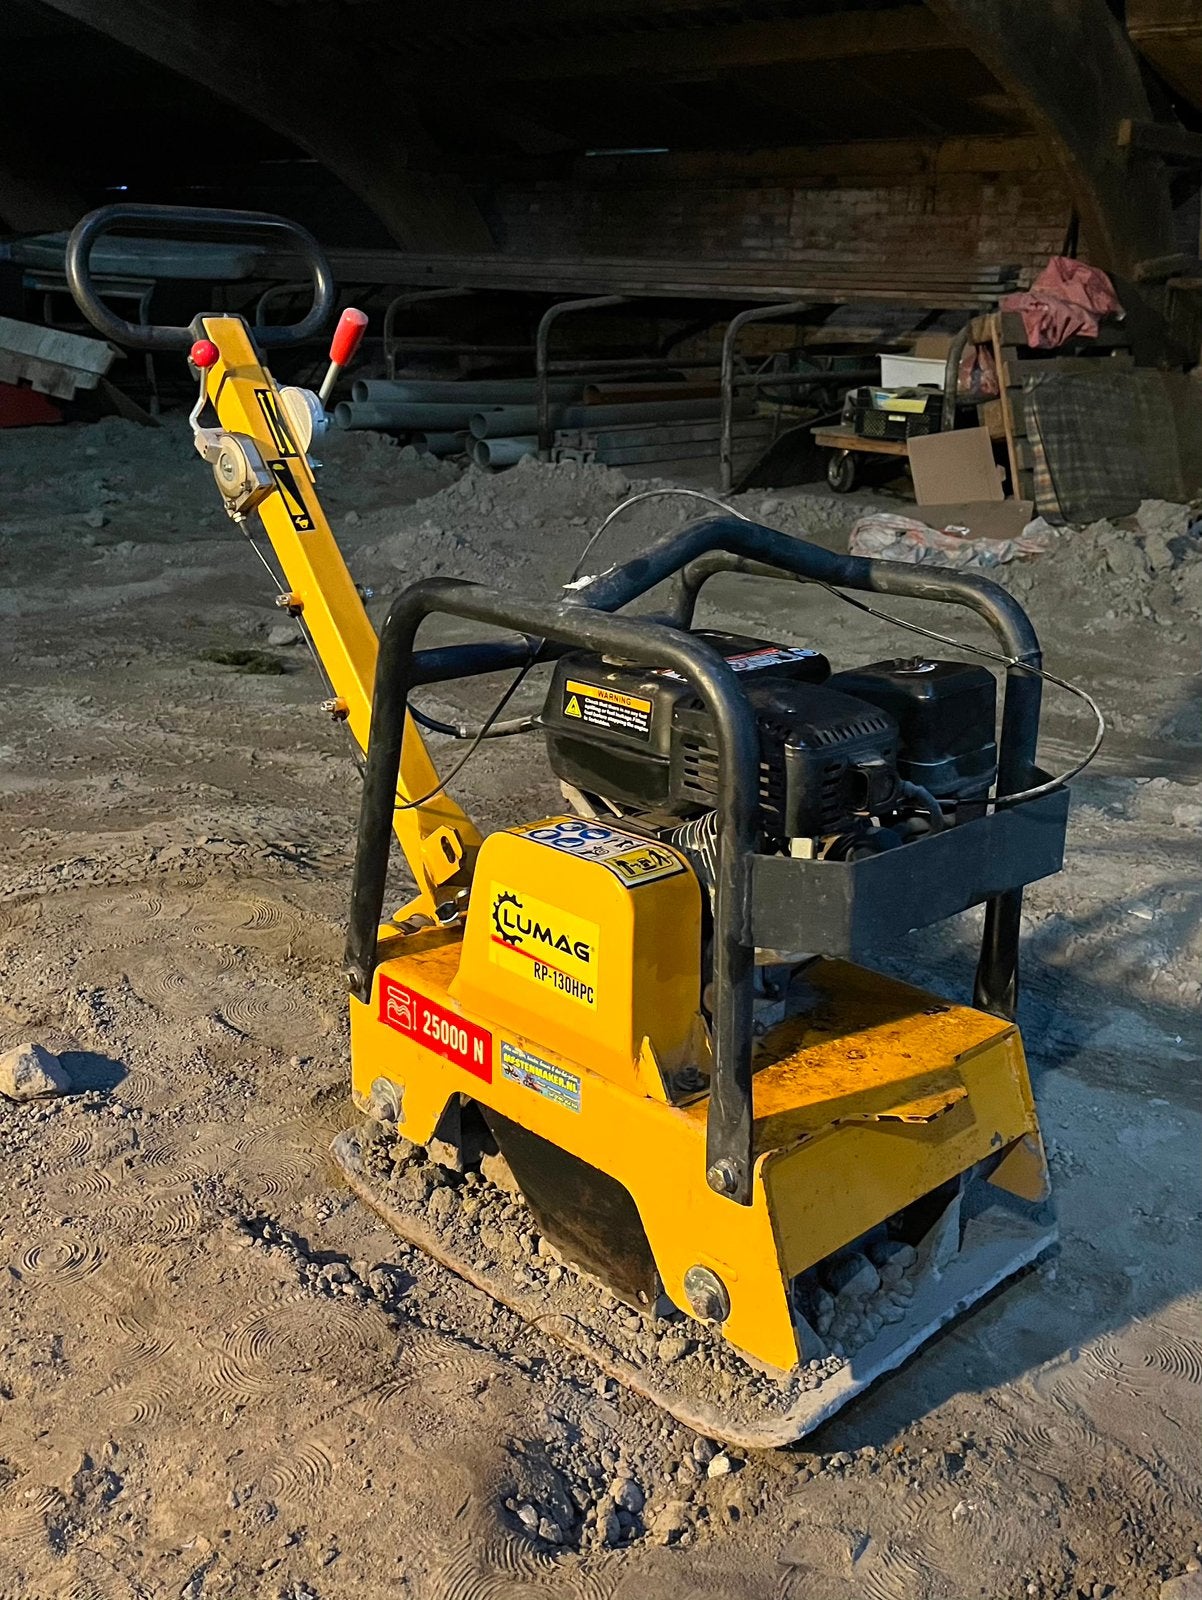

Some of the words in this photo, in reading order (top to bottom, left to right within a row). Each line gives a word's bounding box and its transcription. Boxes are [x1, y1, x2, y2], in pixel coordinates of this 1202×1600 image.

[597, 690, 631, 706] WARNING
[503, 908, 590, 963] LUMAG
[534, 961, 594, 1004] RP-130HPC
[422, 1009, 468, 1055] 25000
[473, 1036, 485, 1065] N
